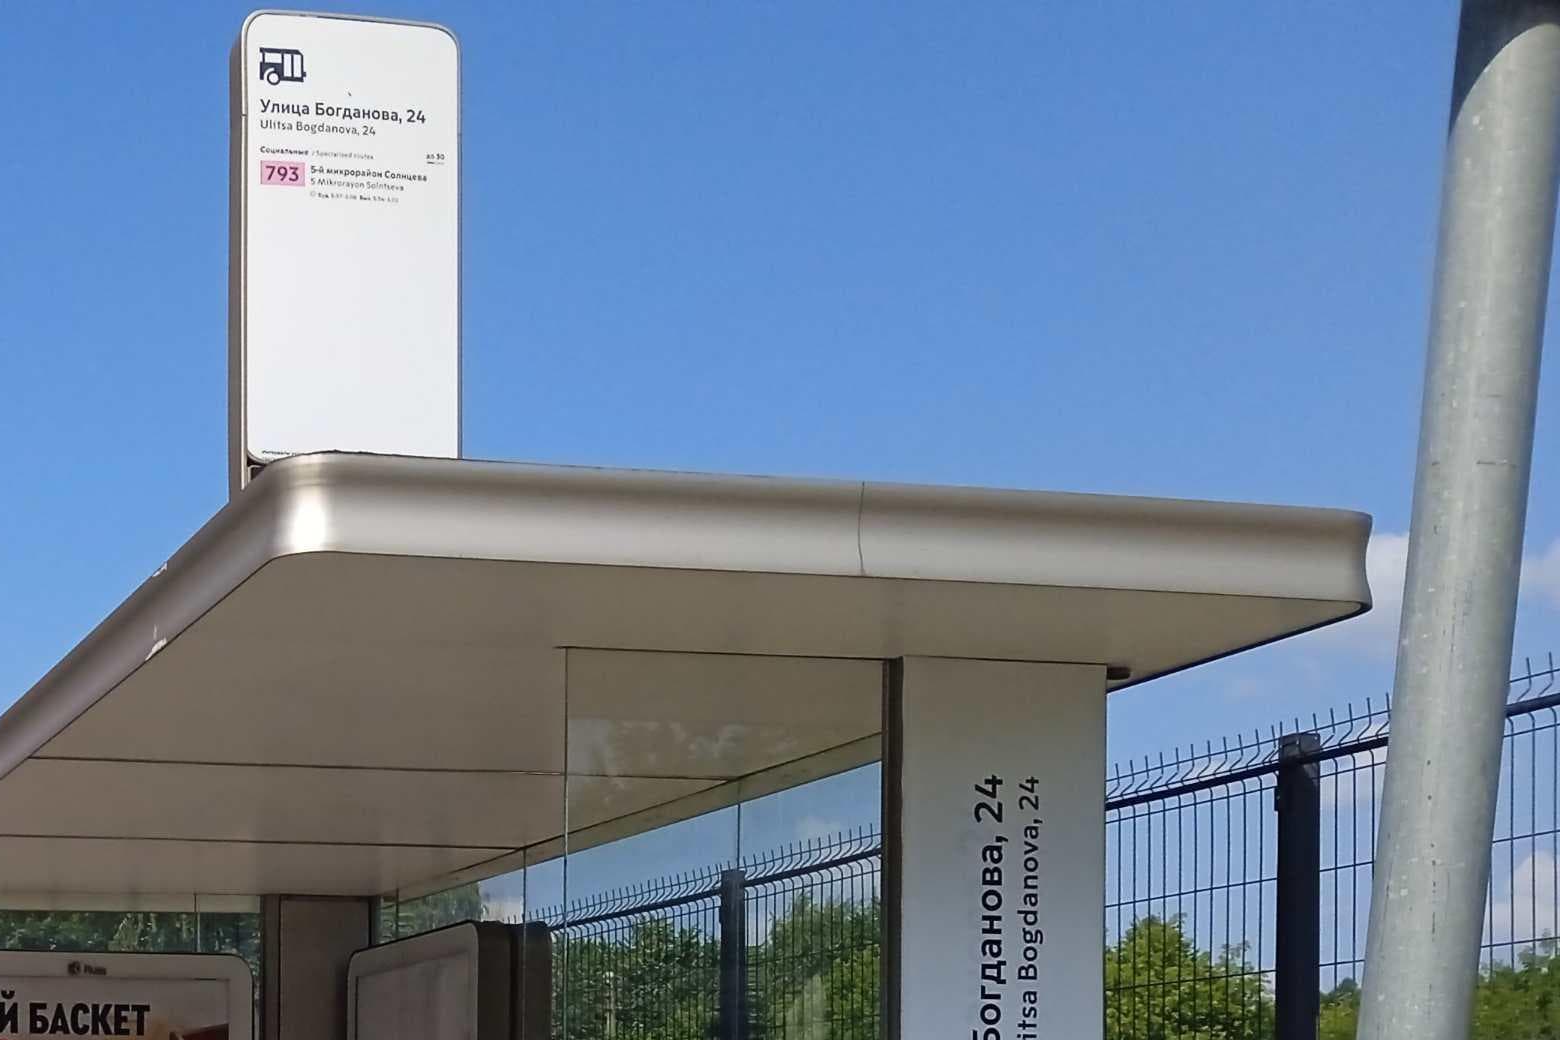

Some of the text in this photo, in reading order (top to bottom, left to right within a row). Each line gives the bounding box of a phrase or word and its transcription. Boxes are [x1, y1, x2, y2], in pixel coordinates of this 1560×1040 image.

[260, 99, 427, 124] Улица Богданова, 24
[260, 119, 377, 136] Ulitsa Bogdanova, 24
[265, 165, 300, 182] 793
[326, 168, 383, 179] микрорайон
[384, 170, 428, 182] Солнцева
[974, 774, 1004, 824] 24
[1018, 775, 1040, 811] 24
[1017, 818, 1044, 981] Bogdanova,
[29, 1001, 151, 1036] БАСКЕТ
